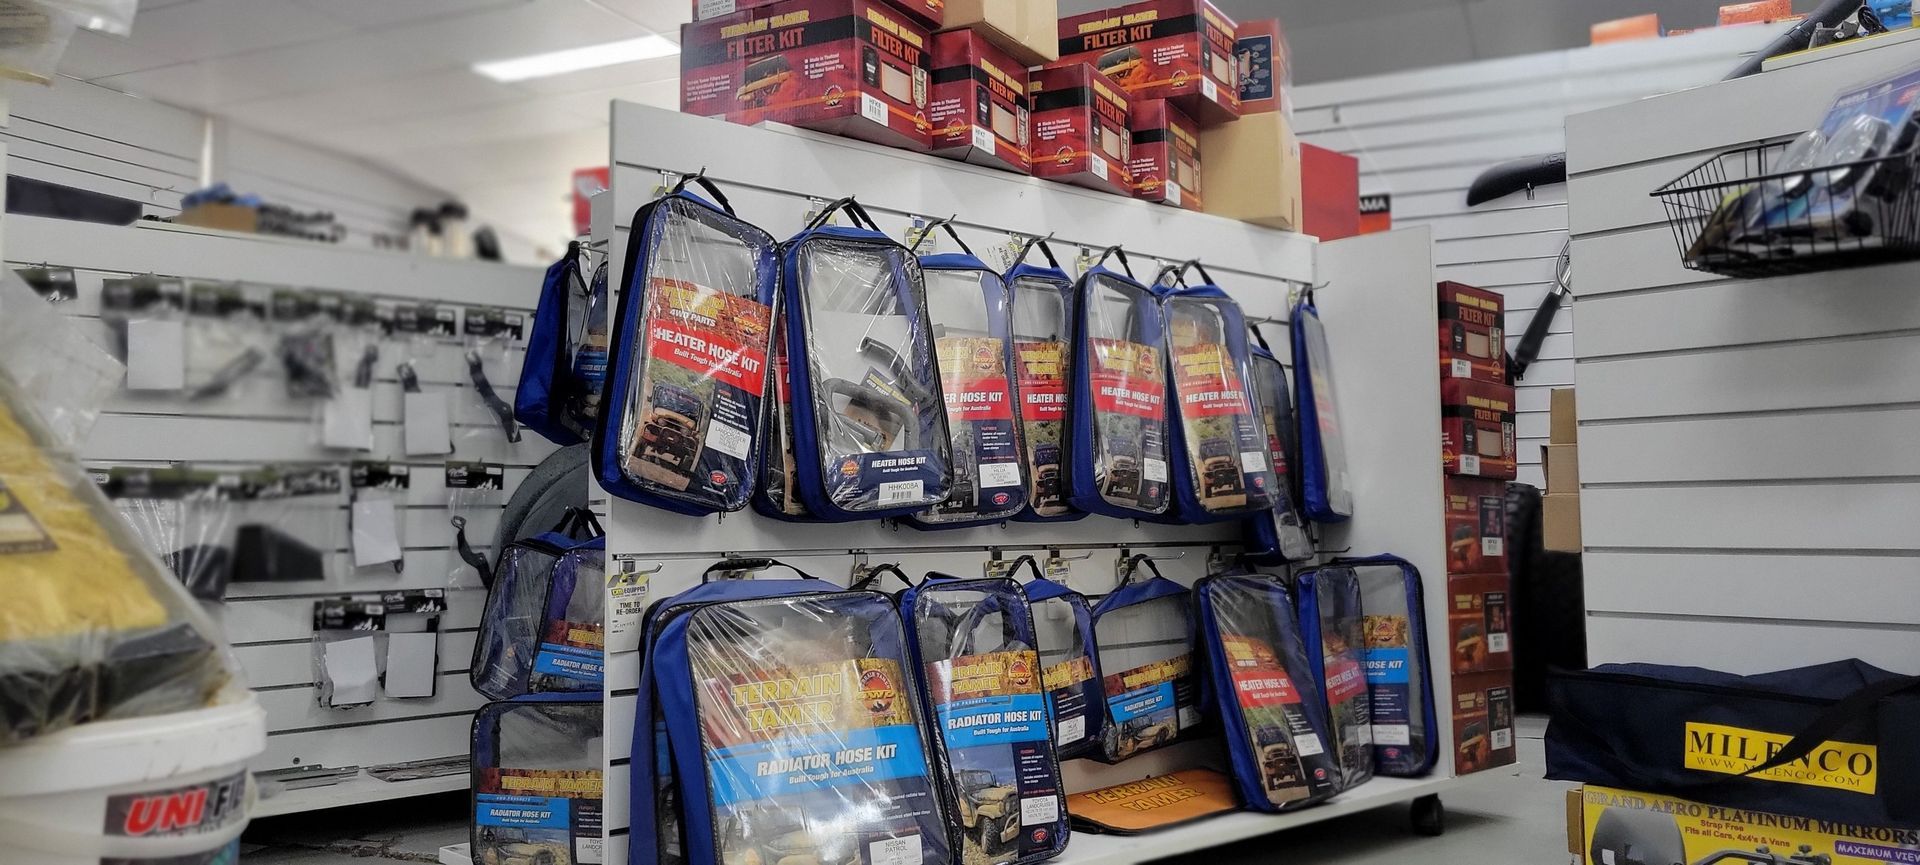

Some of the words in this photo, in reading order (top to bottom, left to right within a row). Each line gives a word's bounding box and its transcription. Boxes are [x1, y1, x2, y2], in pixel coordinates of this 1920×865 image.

[727, 34, 774, 59] FILTER
[780, 28, 804, 48] KIT
[1084, 30, 1126, 50] FILTER
[1130, 24, 1153, 44] KIT
[1206, 23, 1223, 47] FILTER
[871, 26, 902, 58] FILTER
[904, 44, 920, 66] KIT
[988, 77, 1007, 98] FILTER
[1007, 88, 1016, 104] KIT
[1096, 95, 1115, 120] FILTER
[1115, 110, 1126, 126] KIT
[670, 309, 688, 320] 4WD
[690, 312, 716, 327] PARTS
[1459, 306, 1482, 323] FILTER
[1484, 312, 1496, 326] KIT
[656, 327, 705, 352] HEATER
[709, 343, 739, 366] HOSE
[741, 356, 760, 374] KIT
[674, 348, 689, 359] Built
[690, 352, 708, 366] Tough
[960, 392, 986, 403] HOSE
[988, 392, 1003, 402] KIT
[1027, 394, 1054, 403] HEATER
[1056, 394, 1067, 403] HOS
[1101, 386, 1130, 398] HEATER
[1132, 389, 1149, 400] HOSE
[1150, 395, 1160, 404] KIT
[1186, 392, 1219, 403] HEATER
[1221, 392, 1238, 400] HOSE
[1474, 408, 1492, 421] FILTER
[1492, 411, 1501, 422] KIT
[872, 457, 897, 468] HEATER
[898, 457, 915, 466] HOSE
[916, 456, 926, 464] KIT
[552, 658, 581, 668] RADIATOR
[581, 663, 597, 671] HOSE
[951, 661, 1002, 680] ERRAIN
[1389, 660, 1403, 669] KIT
[732, 673, 842, 706] TERRAIN
[953, 676, 1001, 694] TAMER
[1239, 679, 1264, 691] HEATER
[1265, 679, 1280, 688] HOSE
[1281, 678, 1290, 687] KIT
[1124, 701, 1144, 712] RADIATOR
[748, 700, 834, 732] TAMER
[948, 713, 1001, 729] RADIATOR
[1004, 712, 1027, 722] HOSE
[1029, 711, 1042, 720] KIT
[757, 754, 831, 777] RADIATOR
[835, 748, 872, 765] HOSE
[876, 744, 897, 759] KIT
[789, 775, 805, 784] Built
[842, 766, 874, 776] Australia
[1084, 774, 1185, 804] TERRAIN
[1120, 788, 1206, 811] TAMER
[124, 788, 208, 836] UNI
[490, 809, 520, 817] RADIATOR
[1584, 790, 1646, 810] GRAND
[1650, 800, 1701, 818] AERO
[1707, 806, 1810, 831] PLATINUM
[1818, 820, 1918, 845] MIRRORS
[1700, 820, 1723, 830] Strap
[1725, 822, 1744, 831] Free
[1685, 826, 1700, 835] Fits
[1702, 829, 1712, 837] all
[1714, 831, 1735, 840] Cars,
[1737, 834, 1758, 843] 4x4's
[1771, 838, 1790, 847] Vans
[1838, 844, 1892, 858] MAXIMUM
